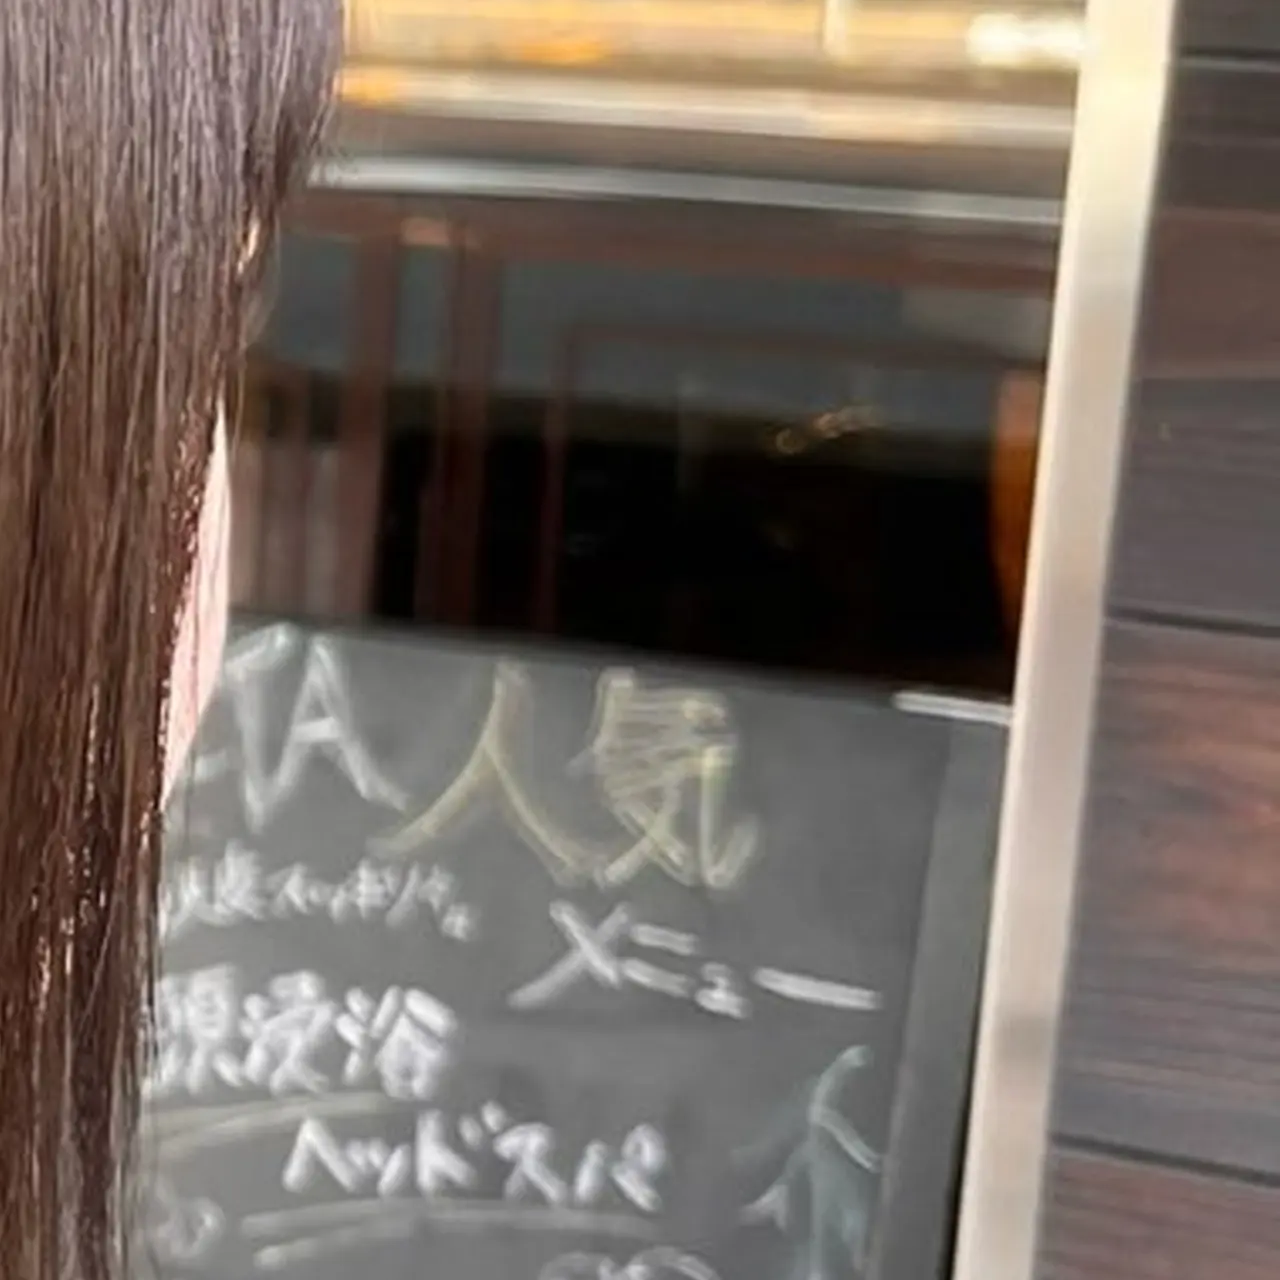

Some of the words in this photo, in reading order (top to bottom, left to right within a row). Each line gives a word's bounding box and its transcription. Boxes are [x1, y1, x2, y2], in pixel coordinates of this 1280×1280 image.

[366, 656, 760, 892] 人気
[506, 900, 885, 1022] メニュー
[280, 1100, 668, 1212] ヘッドスパ
